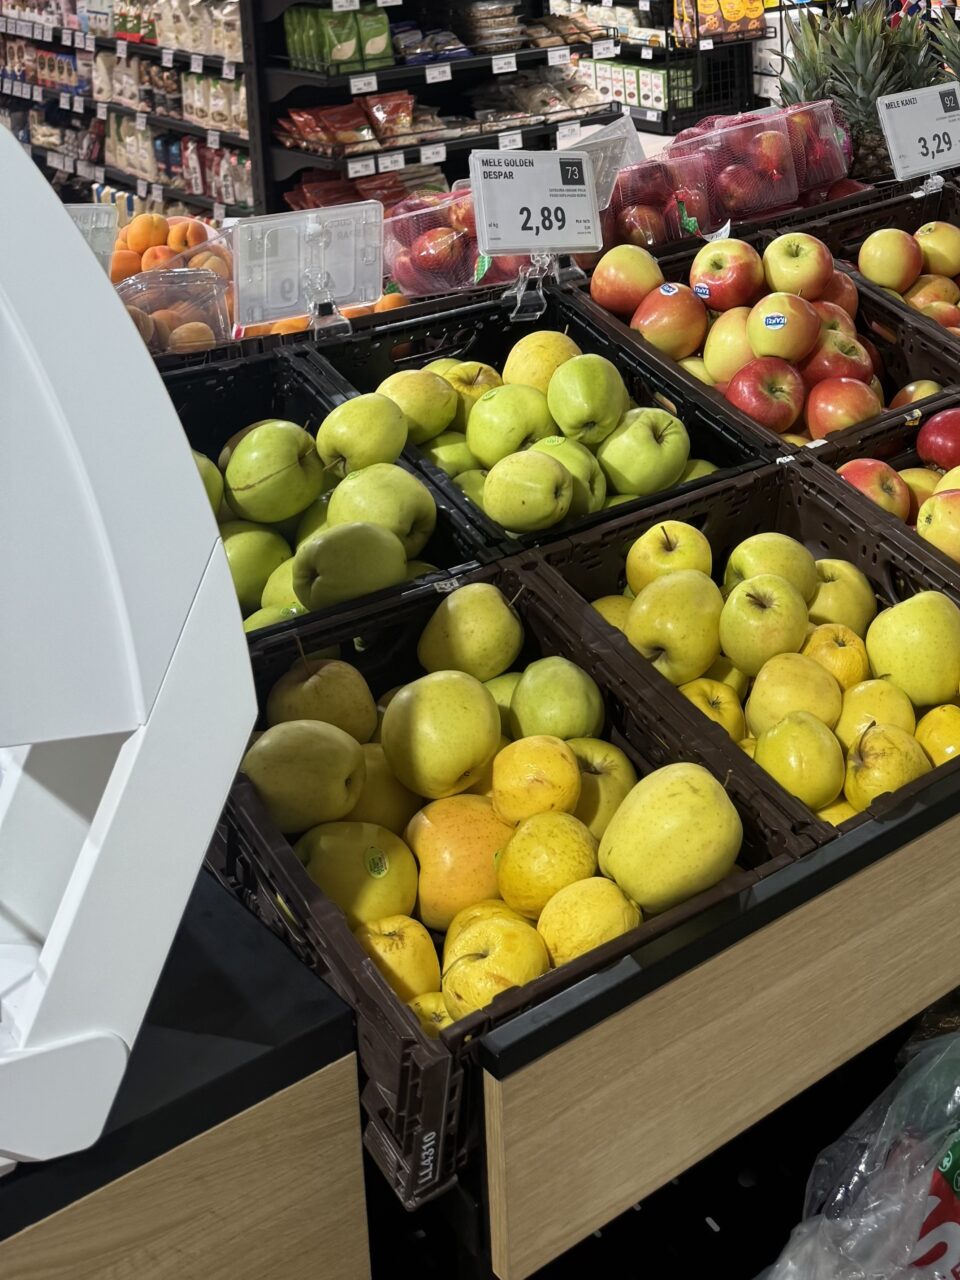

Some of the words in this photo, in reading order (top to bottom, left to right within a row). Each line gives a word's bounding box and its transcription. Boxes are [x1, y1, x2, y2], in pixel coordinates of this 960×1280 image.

[885, 99, 901, 110] MELE
[901, 97, 918, 107] KANZI
[944, 96, 956, 107] 92
[917, 131, 952, 160] 3,29
[481, 158, 503, 168] MELE
[504, 158, 534, 168] GOLDEN
[483, 171, 514, 180] DESPAR
[565, 166, 579, 179] 73
[519, 206, 566, 236] 2,89
